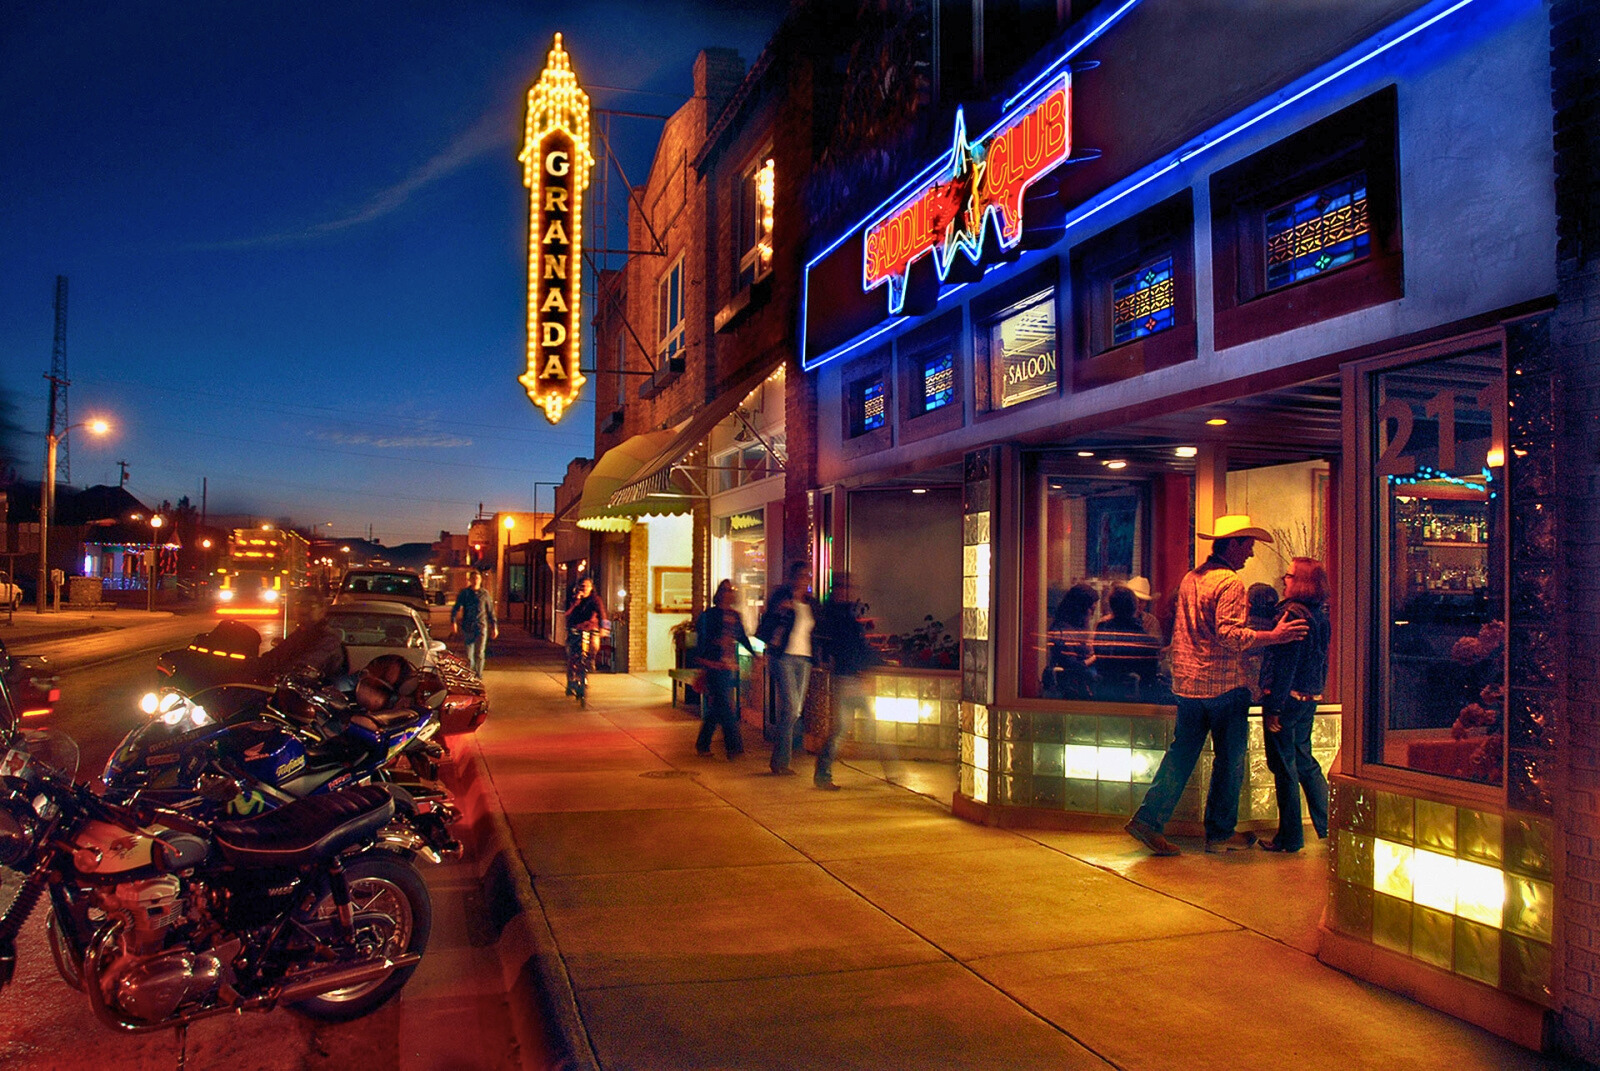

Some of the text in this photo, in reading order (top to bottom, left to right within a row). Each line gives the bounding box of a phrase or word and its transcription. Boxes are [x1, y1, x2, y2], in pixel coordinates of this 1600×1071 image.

[988, 90, 1066, 195] CLUB
[538, 151, 570, 379] GRANADA
[1009, 350, 1056, 385] SALOON
[1375, 381, 1506, 476] 211
